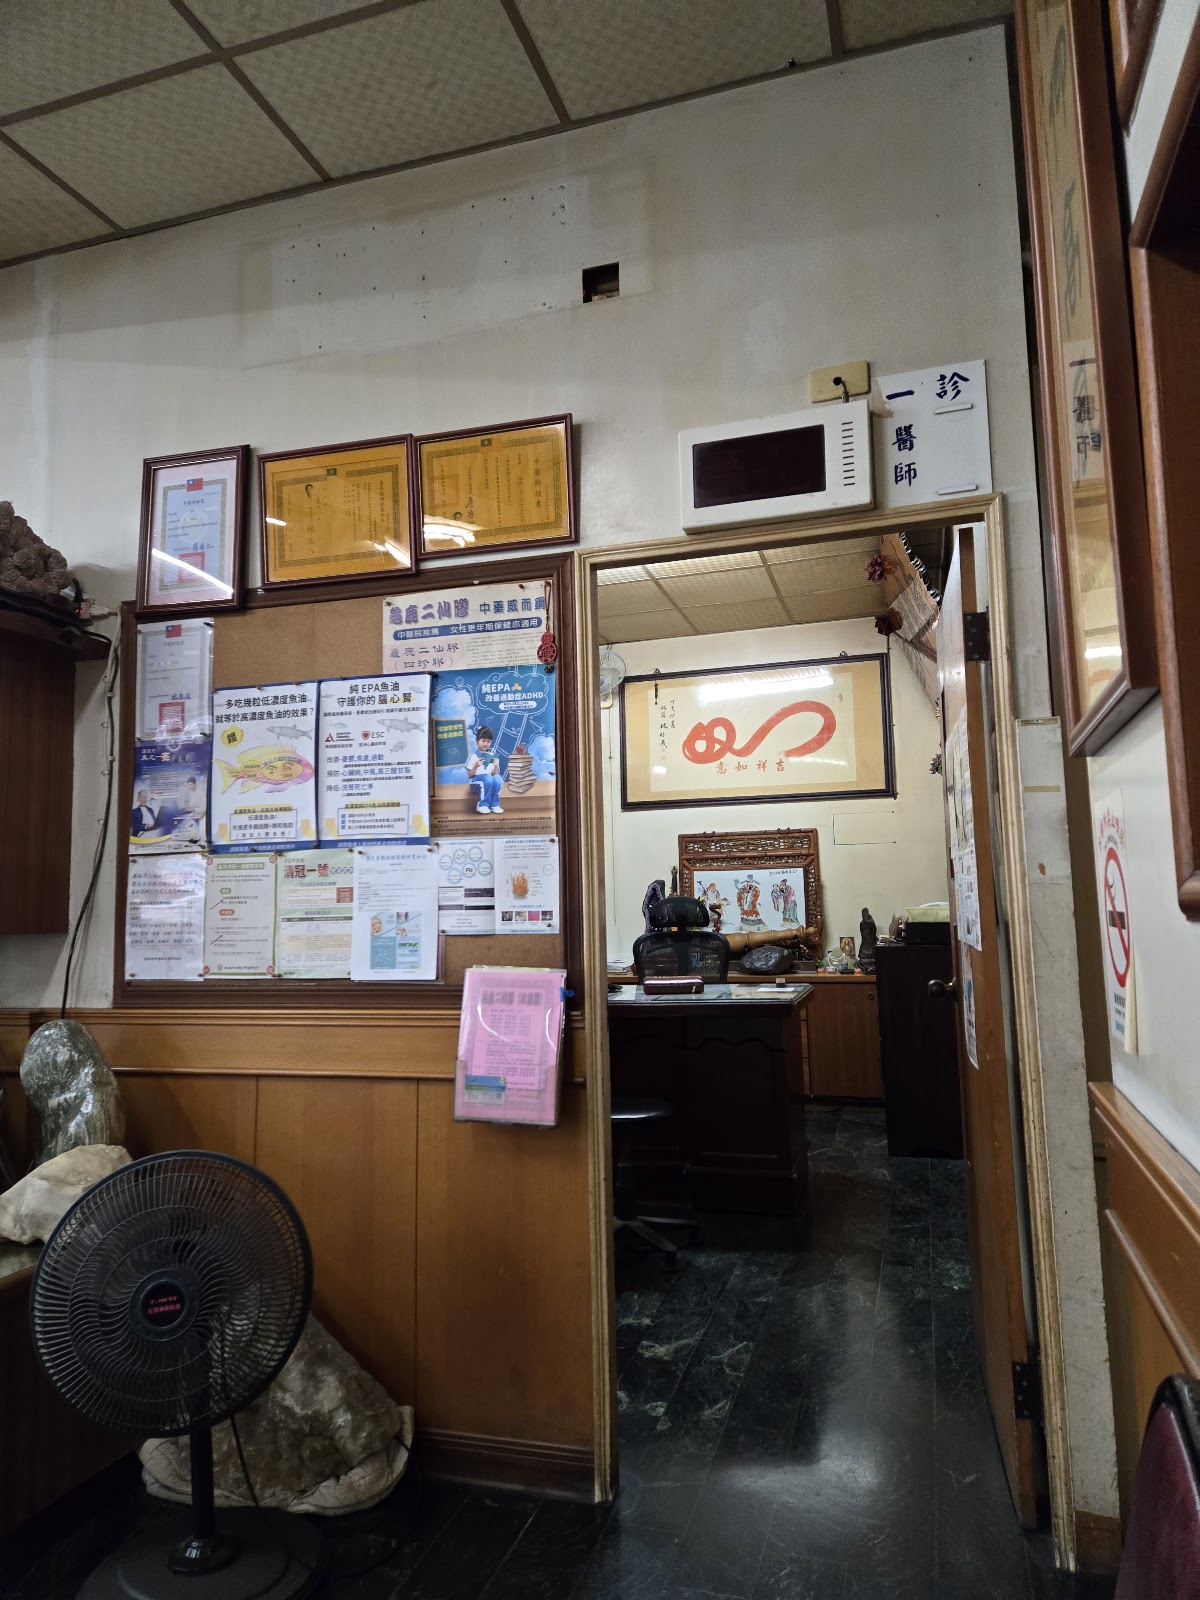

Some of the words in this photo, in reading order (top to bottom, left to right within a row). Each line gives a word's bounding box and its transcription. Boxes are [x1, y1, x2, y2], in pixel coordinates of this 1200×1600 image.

[892, 423, 918, 487] 醫師
[481, 683, 510, 693] 純EPA
[225, 693, 307, 709] 多吃幾粒低濃度魚油
[485, 691, 544, 702] 改善過動症ADHD
[371, 731, 385, 739] ESC
[283, 864, 329, 878] 清冠一號
